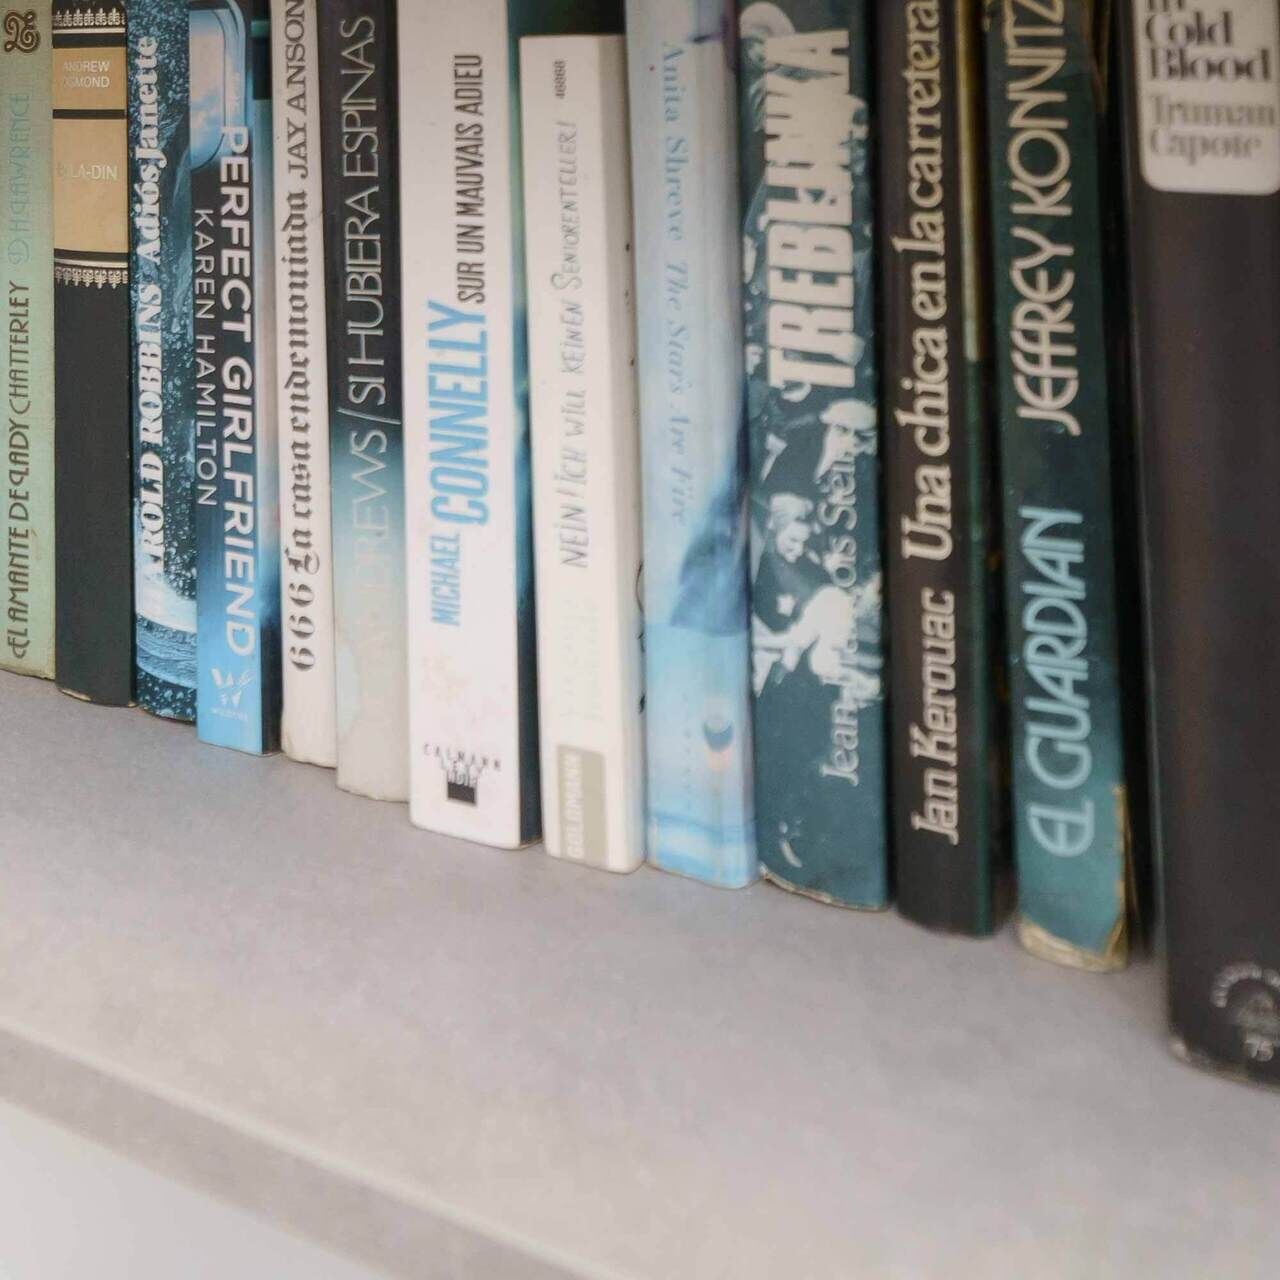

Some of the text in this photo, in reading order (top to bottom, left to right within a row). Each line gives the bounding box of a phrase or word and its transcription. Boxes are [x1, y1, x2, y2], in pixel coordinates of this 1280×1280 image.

[63, 59, 111, 73] ANDREW
[1144, 10, 1234, 47] Cold
[1147, 47, 1271, 83] Blood
[286, 115, 309, 180] JAY
[1147, 93, 1276, 128] Truman
[1147, 127, 1264, 161] Capote
[339, 15, 386, 367] HUBIERA ESPINAS
[891, 209, 947, 254] la
[133, 35, 168, 448] ROBBINS Janette
[281, 190, 312, 435] endemoniada
[911, 255, 948, 321] en
[1009, 224, 1082, 438] JEFFREY
[194, 208, 218, 507] KAREN HAMILTON
[427, 54, 489, 626] MICHAEL CONNELLY SUR UN MAUVAIS ADIEU
[220, 125, 257, 658] PERFECT GIRLFRIEND
[894, 325, 950, 458] chica
[7, 280, 32, 624] AMANTE CHATTERLEY
[290, 441, 312, 520] casa
[286, 525, 320, 575] La
[900, 465, 953, 562] Una
[908, 586, 959, 766] Kerouac
[1021, 504, 1095, 790] GUARDIAN
[909, 769, 959, 845] Jan
[1027, 797, 1096, 858] EL
